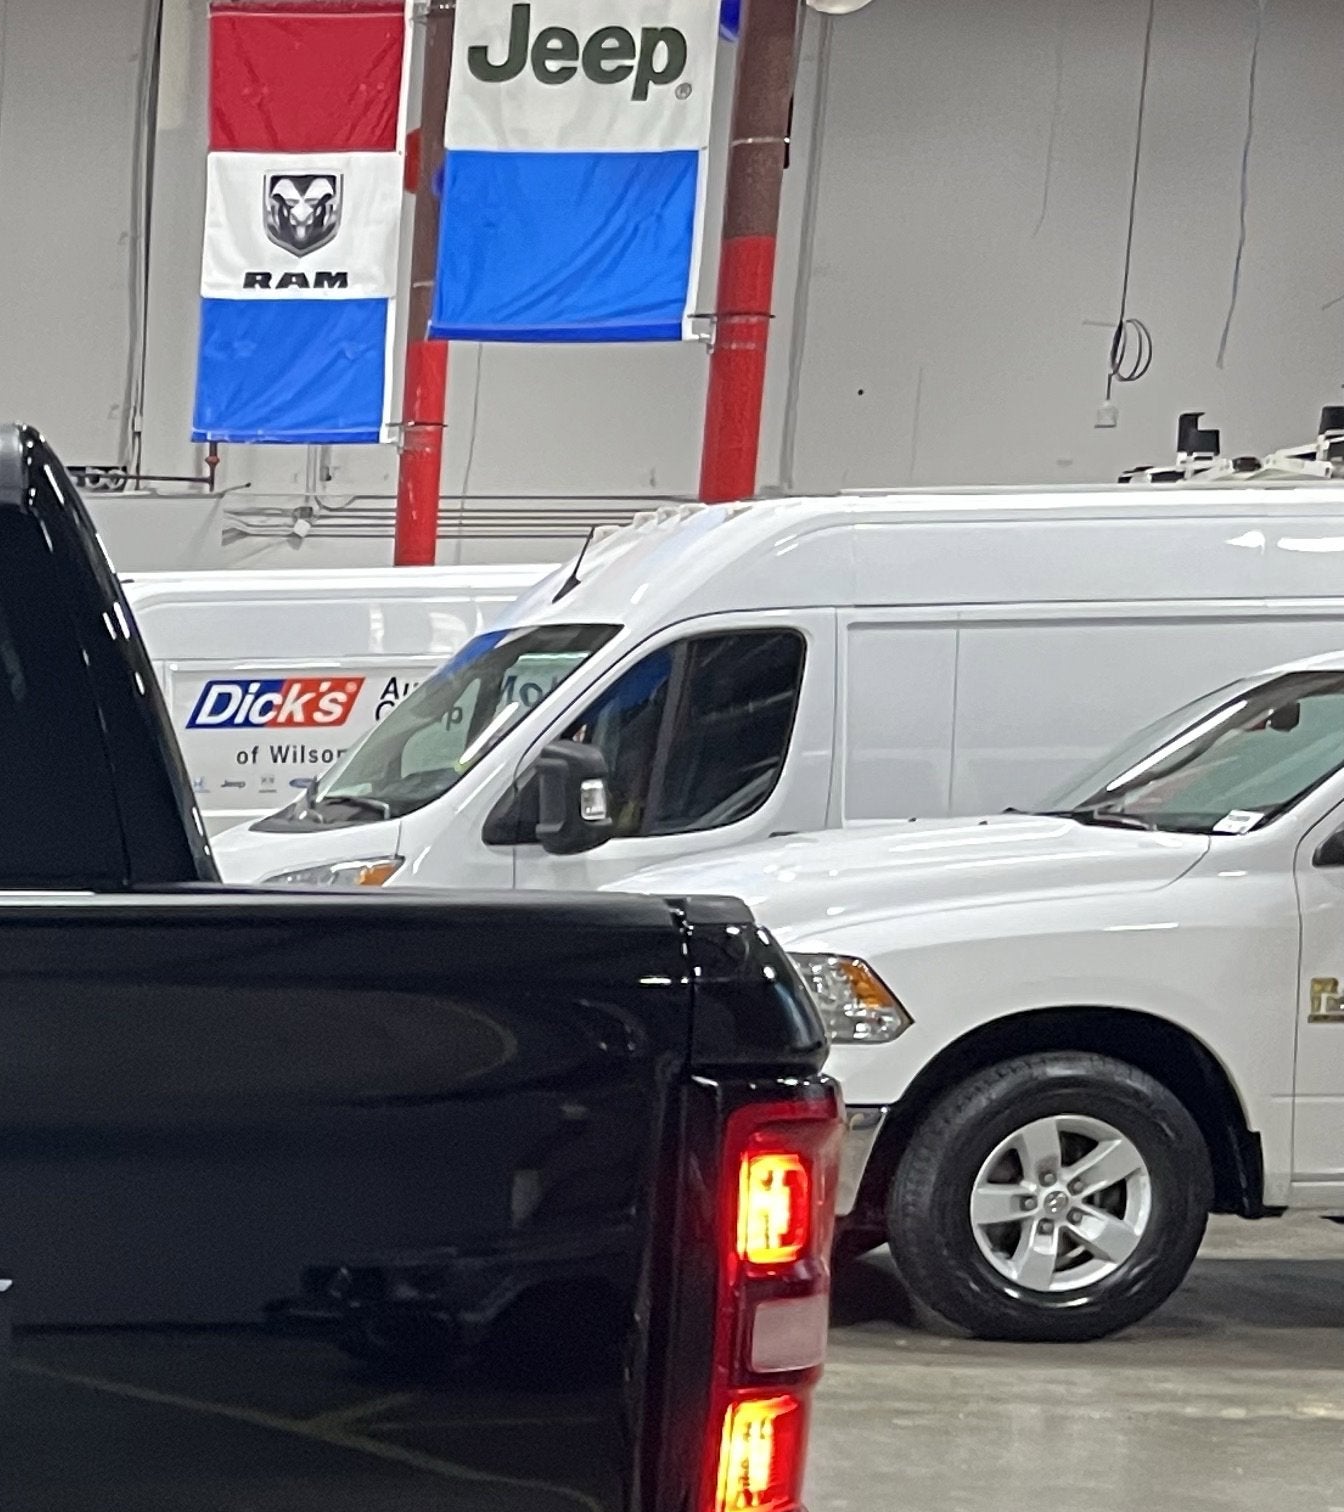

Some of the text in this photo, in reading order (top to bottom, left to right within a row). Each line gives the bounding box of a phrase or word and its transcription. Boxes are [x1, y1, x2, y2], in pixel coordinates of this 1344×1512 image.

[468, 3, 688, 102] Jeep
[243, 271, 348, 289] RAM
[195, 681, 348, 725] Dick's
[236, 746, 259, 764] of
